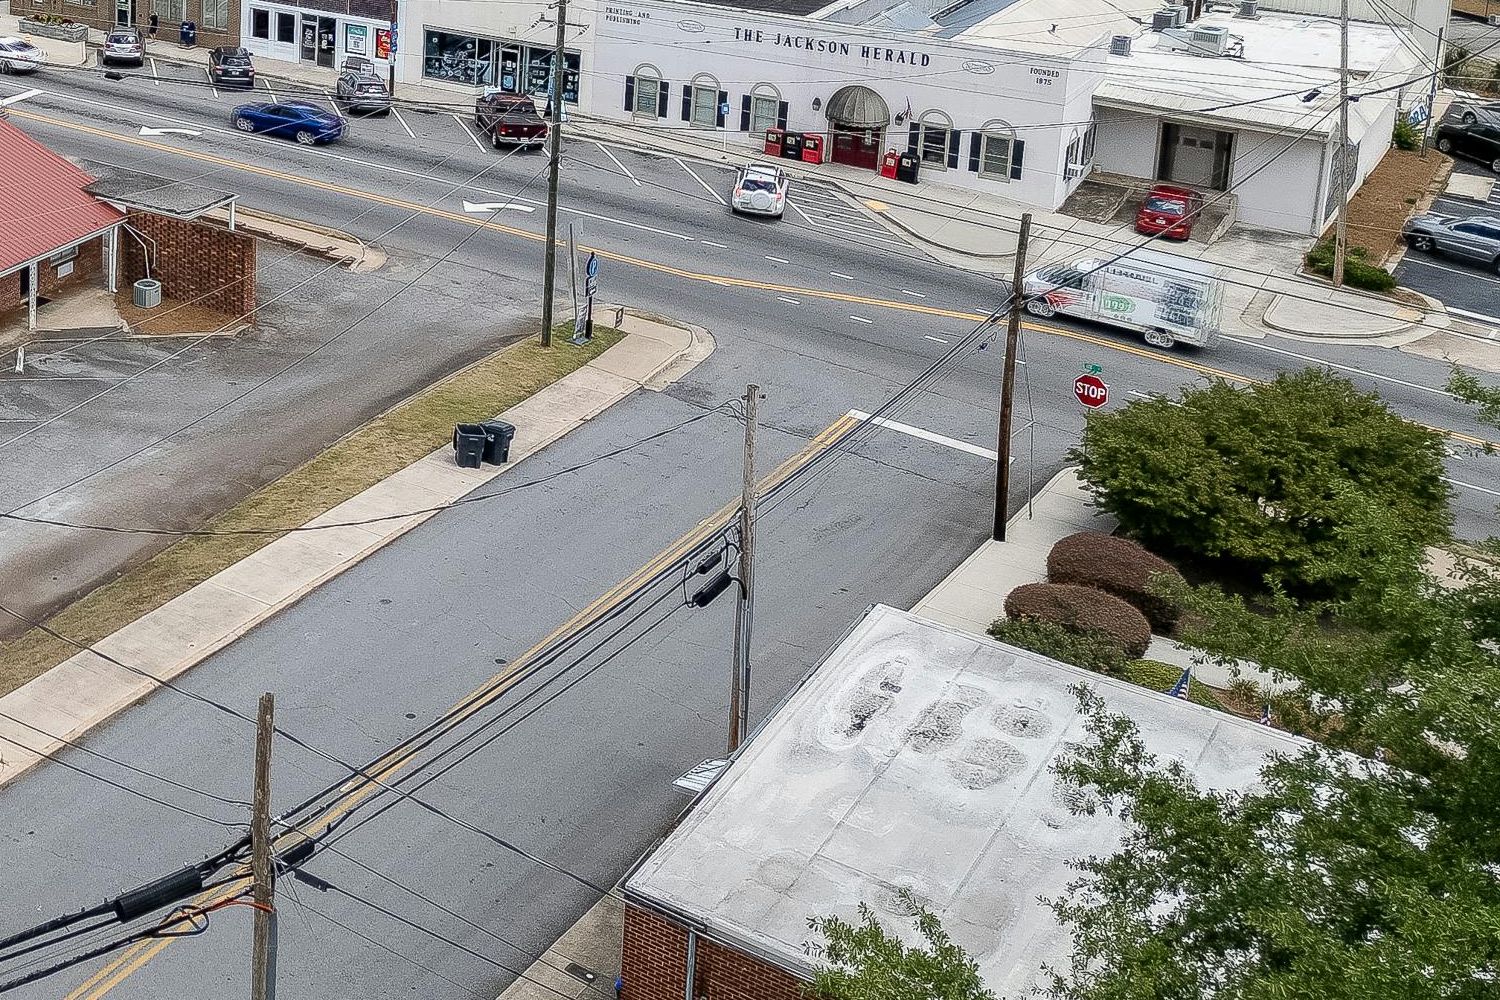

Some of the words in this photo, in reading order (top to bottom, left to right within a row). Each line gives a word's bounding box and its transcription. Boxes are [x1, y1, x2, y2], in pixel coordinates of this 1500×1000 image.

[605, 6, 633, 17] PRINTING
[636, 11, 651, 19] AND
[605, 15, 641, 26] PUBLISHING
[733, 27, 764, 43] THE
[773, 32, 850, 56] JACKSON
[861, 45, 931, 67] HERALD
[1029, 67, 1060, 78] FOUNDED
[1036, 77, 1052, 86] 1875
[1075, 381, 1106, 400] STOP
